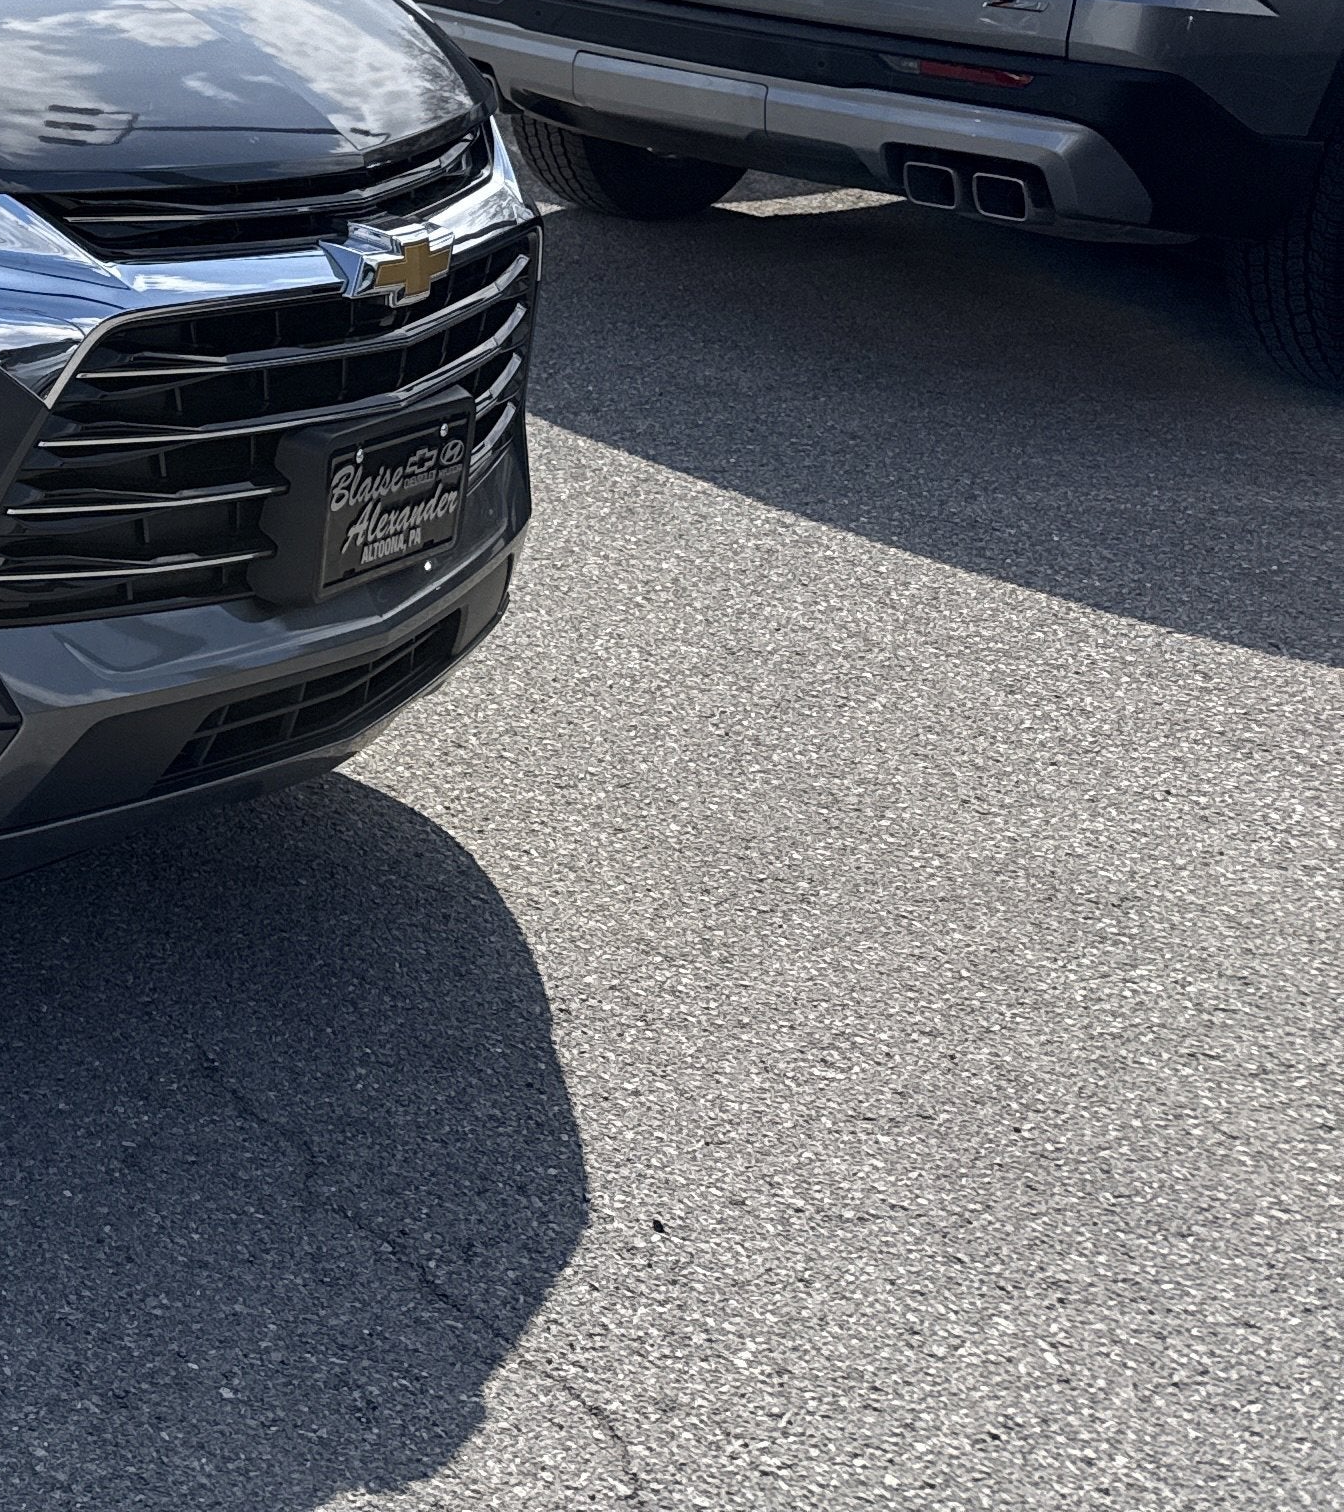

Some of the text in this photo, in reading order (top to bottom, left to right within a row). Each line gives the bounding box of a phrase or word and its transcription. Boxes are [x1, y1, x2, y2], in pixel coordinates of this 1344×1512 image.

[330, 462, 404, 512] Blaise
[341, 482, 459, 555] Alexander
[361, 527, 422, 564] ALTOONA, PA
